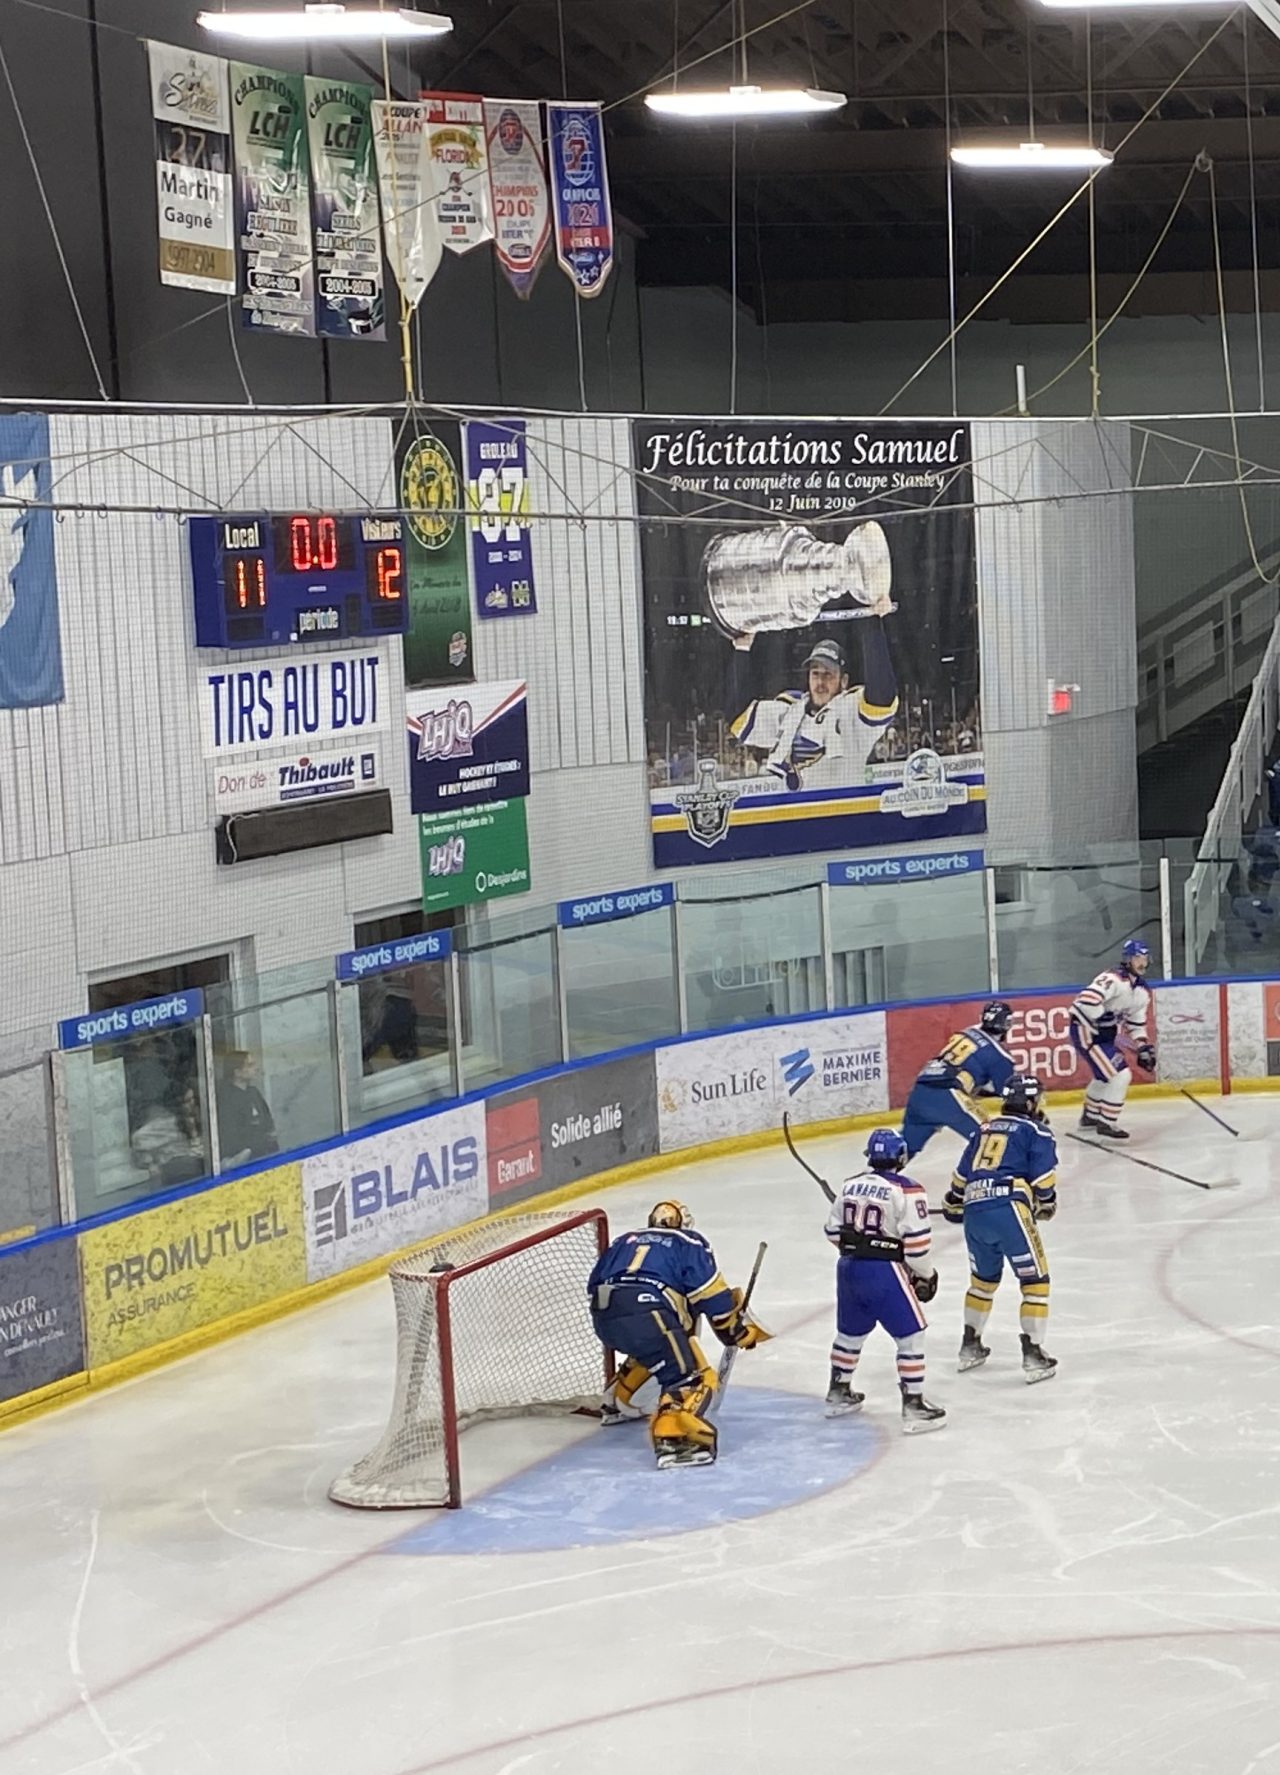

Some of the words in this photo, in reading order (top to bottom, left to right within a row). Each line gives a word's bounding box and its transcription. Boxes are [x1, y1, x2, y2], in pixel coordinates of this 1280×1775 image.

[250, 110, 291, 138] LCH
[323, 122, 362, 150] LCH
[171, 126, 206, 167] 27
[161, 171, 219, 202] Martin
[164, 206, 213, 229] Gagné
[643, 429, 842, 473] Félicitations
[851, 428, 965, 465] Samuel
[670, 475, 708, 492] Pour
[713, 477, 729, 490] ta
[733, 472, 802, 494] conquête
[805, 473, 823, 489] de
[827, 473, 841, 489] la
[845, 473, 889, 494] Coupe
[891, 470, 946, 493] Stanley
[769, 496, 783, 511] 12
[787, 495, 821, 513] Juin
[824, 496, 857, 512] 2019
[224, 521, 260, 549] Local
[236, 558, 267, 609] 11
[376, 547, 401, 600] 12
[208, 669, 273, 747] TIRS
[283, 664, 318, 737] AU
[331, 657, 379, 730] BUT
[218, 774, 245, 794] Don
[249, 771, 267, 789] de
[278, 756, 355, 787] Thibault
[487, 868, 527, 888] Desjardins
[846, 858, 900, 881] sports
[905, 853, 969, 875] experts
[572, 894, 614, 919] sports
[618, 887, 664, 912] experts
[351, 947, 393, 973] sports
[394, 936, 440, 962] experts
[77, 1012, 128, 1041] sports
[131, 996, 188, 1027] experts
[823, 1051, 881, 1072] MAXIME
[823, 1067, 882, 1087] BERNIER
[691, 1079, 727, 1104] Sun
[730, 1068, 767, 1095] Life
[551, 1113, 592, 1148] Solide
[593, 1102, 622, 1135] allié
[497, 1150, 535, 1184] Garant
[972, 1133, 1009, 1172] 19
[351, 1136, 479, 1219] BLAIS
[105, 1205, 289, 1300] PROMUTUEL
[626, 1245, 651, 1273] 1
[108, 1281, 196, 1329] ASSURANCE
